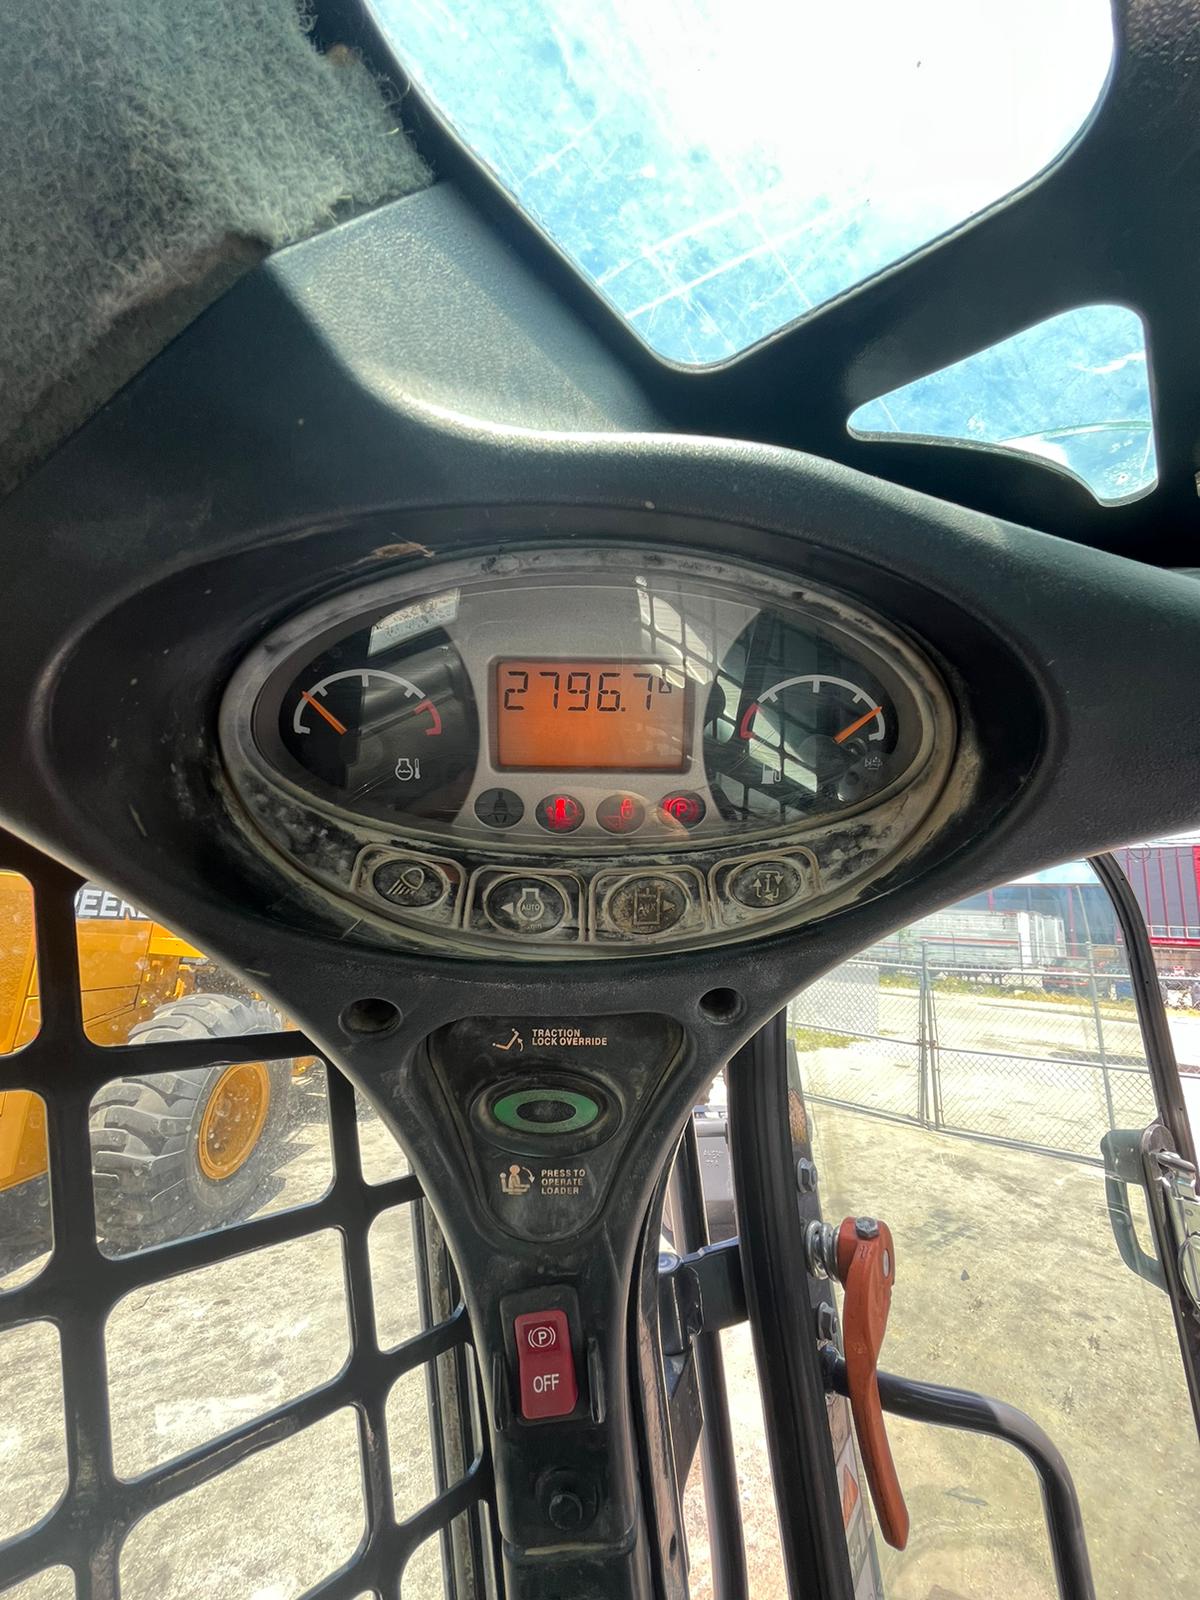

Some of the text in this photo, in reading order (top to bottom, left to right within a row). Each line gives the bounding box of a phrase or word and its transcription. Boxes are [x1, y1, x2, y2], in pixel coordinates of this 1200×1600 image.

[503, 671, 654, 712] 2796.7
[521, 903, 540, 911] AUTO
[532, 1028, 581, 1037] TRACTION
[532, 1037, 608, 1046] LOCK OVERRIDE
[541, 1169, 586, 1177] PRESS TO
[541, 1178, 583, 1186] OPERATE
[541, 1187, 579, 1195] LOADER
[533, 1373, 560, 1393] OFF
